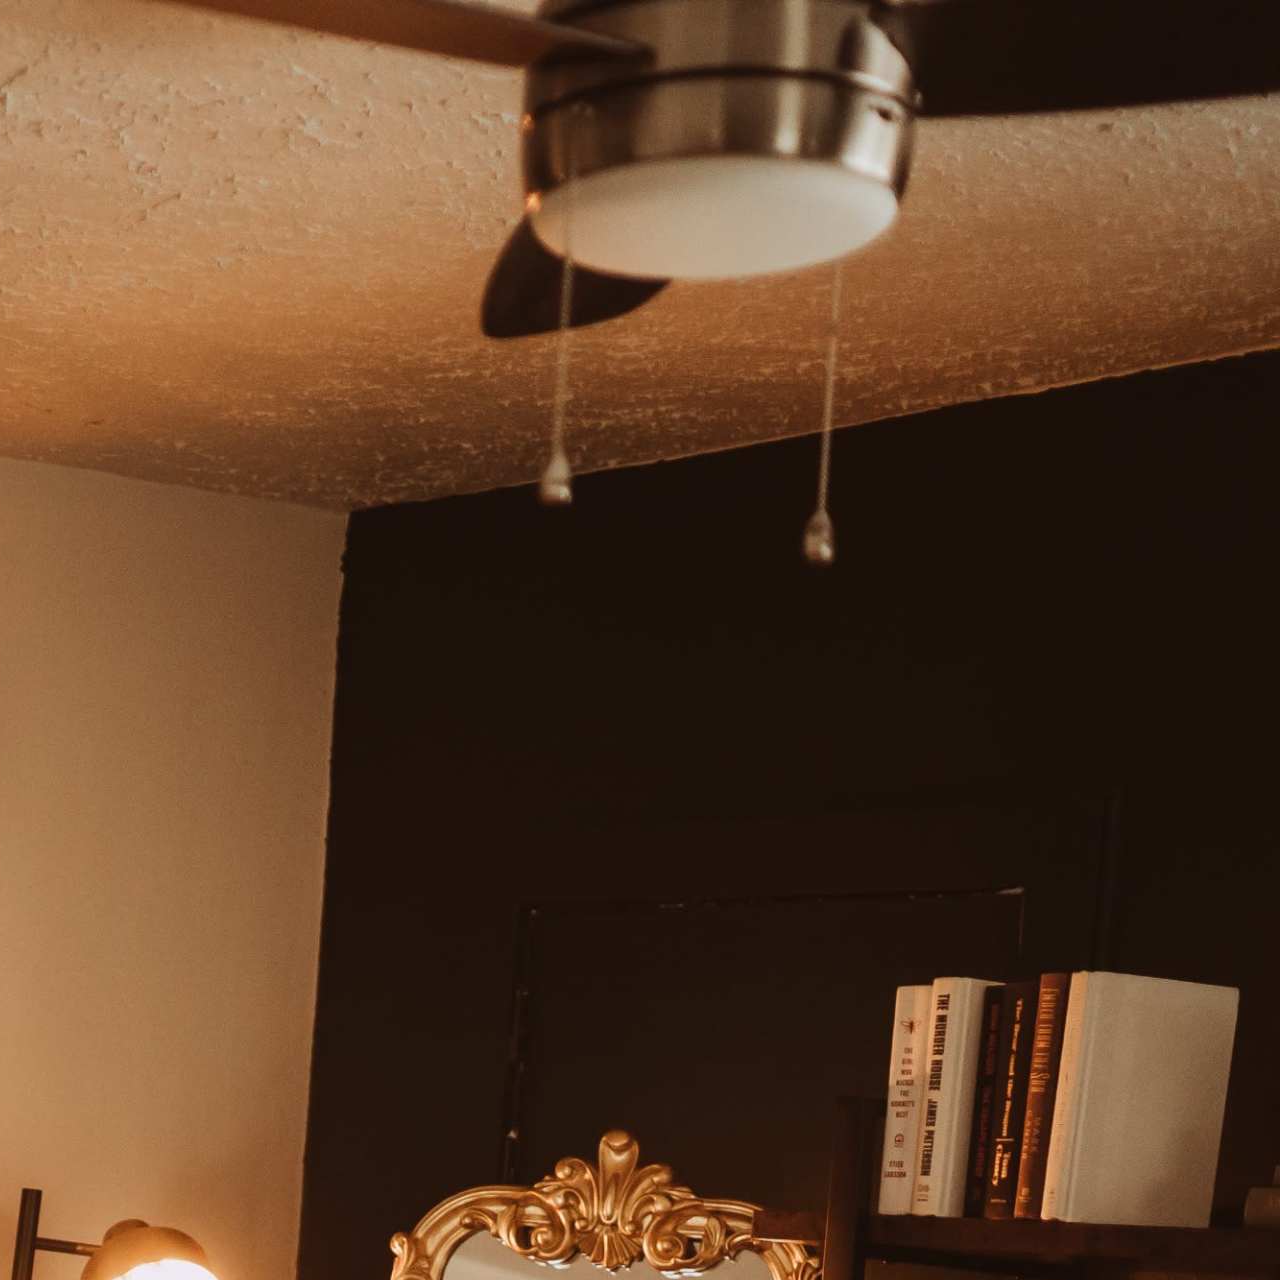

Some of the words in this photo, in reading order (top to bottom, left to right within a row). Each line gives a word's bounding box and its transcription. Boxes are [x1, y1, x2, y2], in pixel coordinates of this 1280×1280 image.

[937, 993, 951, 1011] THE
[932, 1014, 948, 1055] MURDER
[928, 1059, 943, 1091] HOUSE
